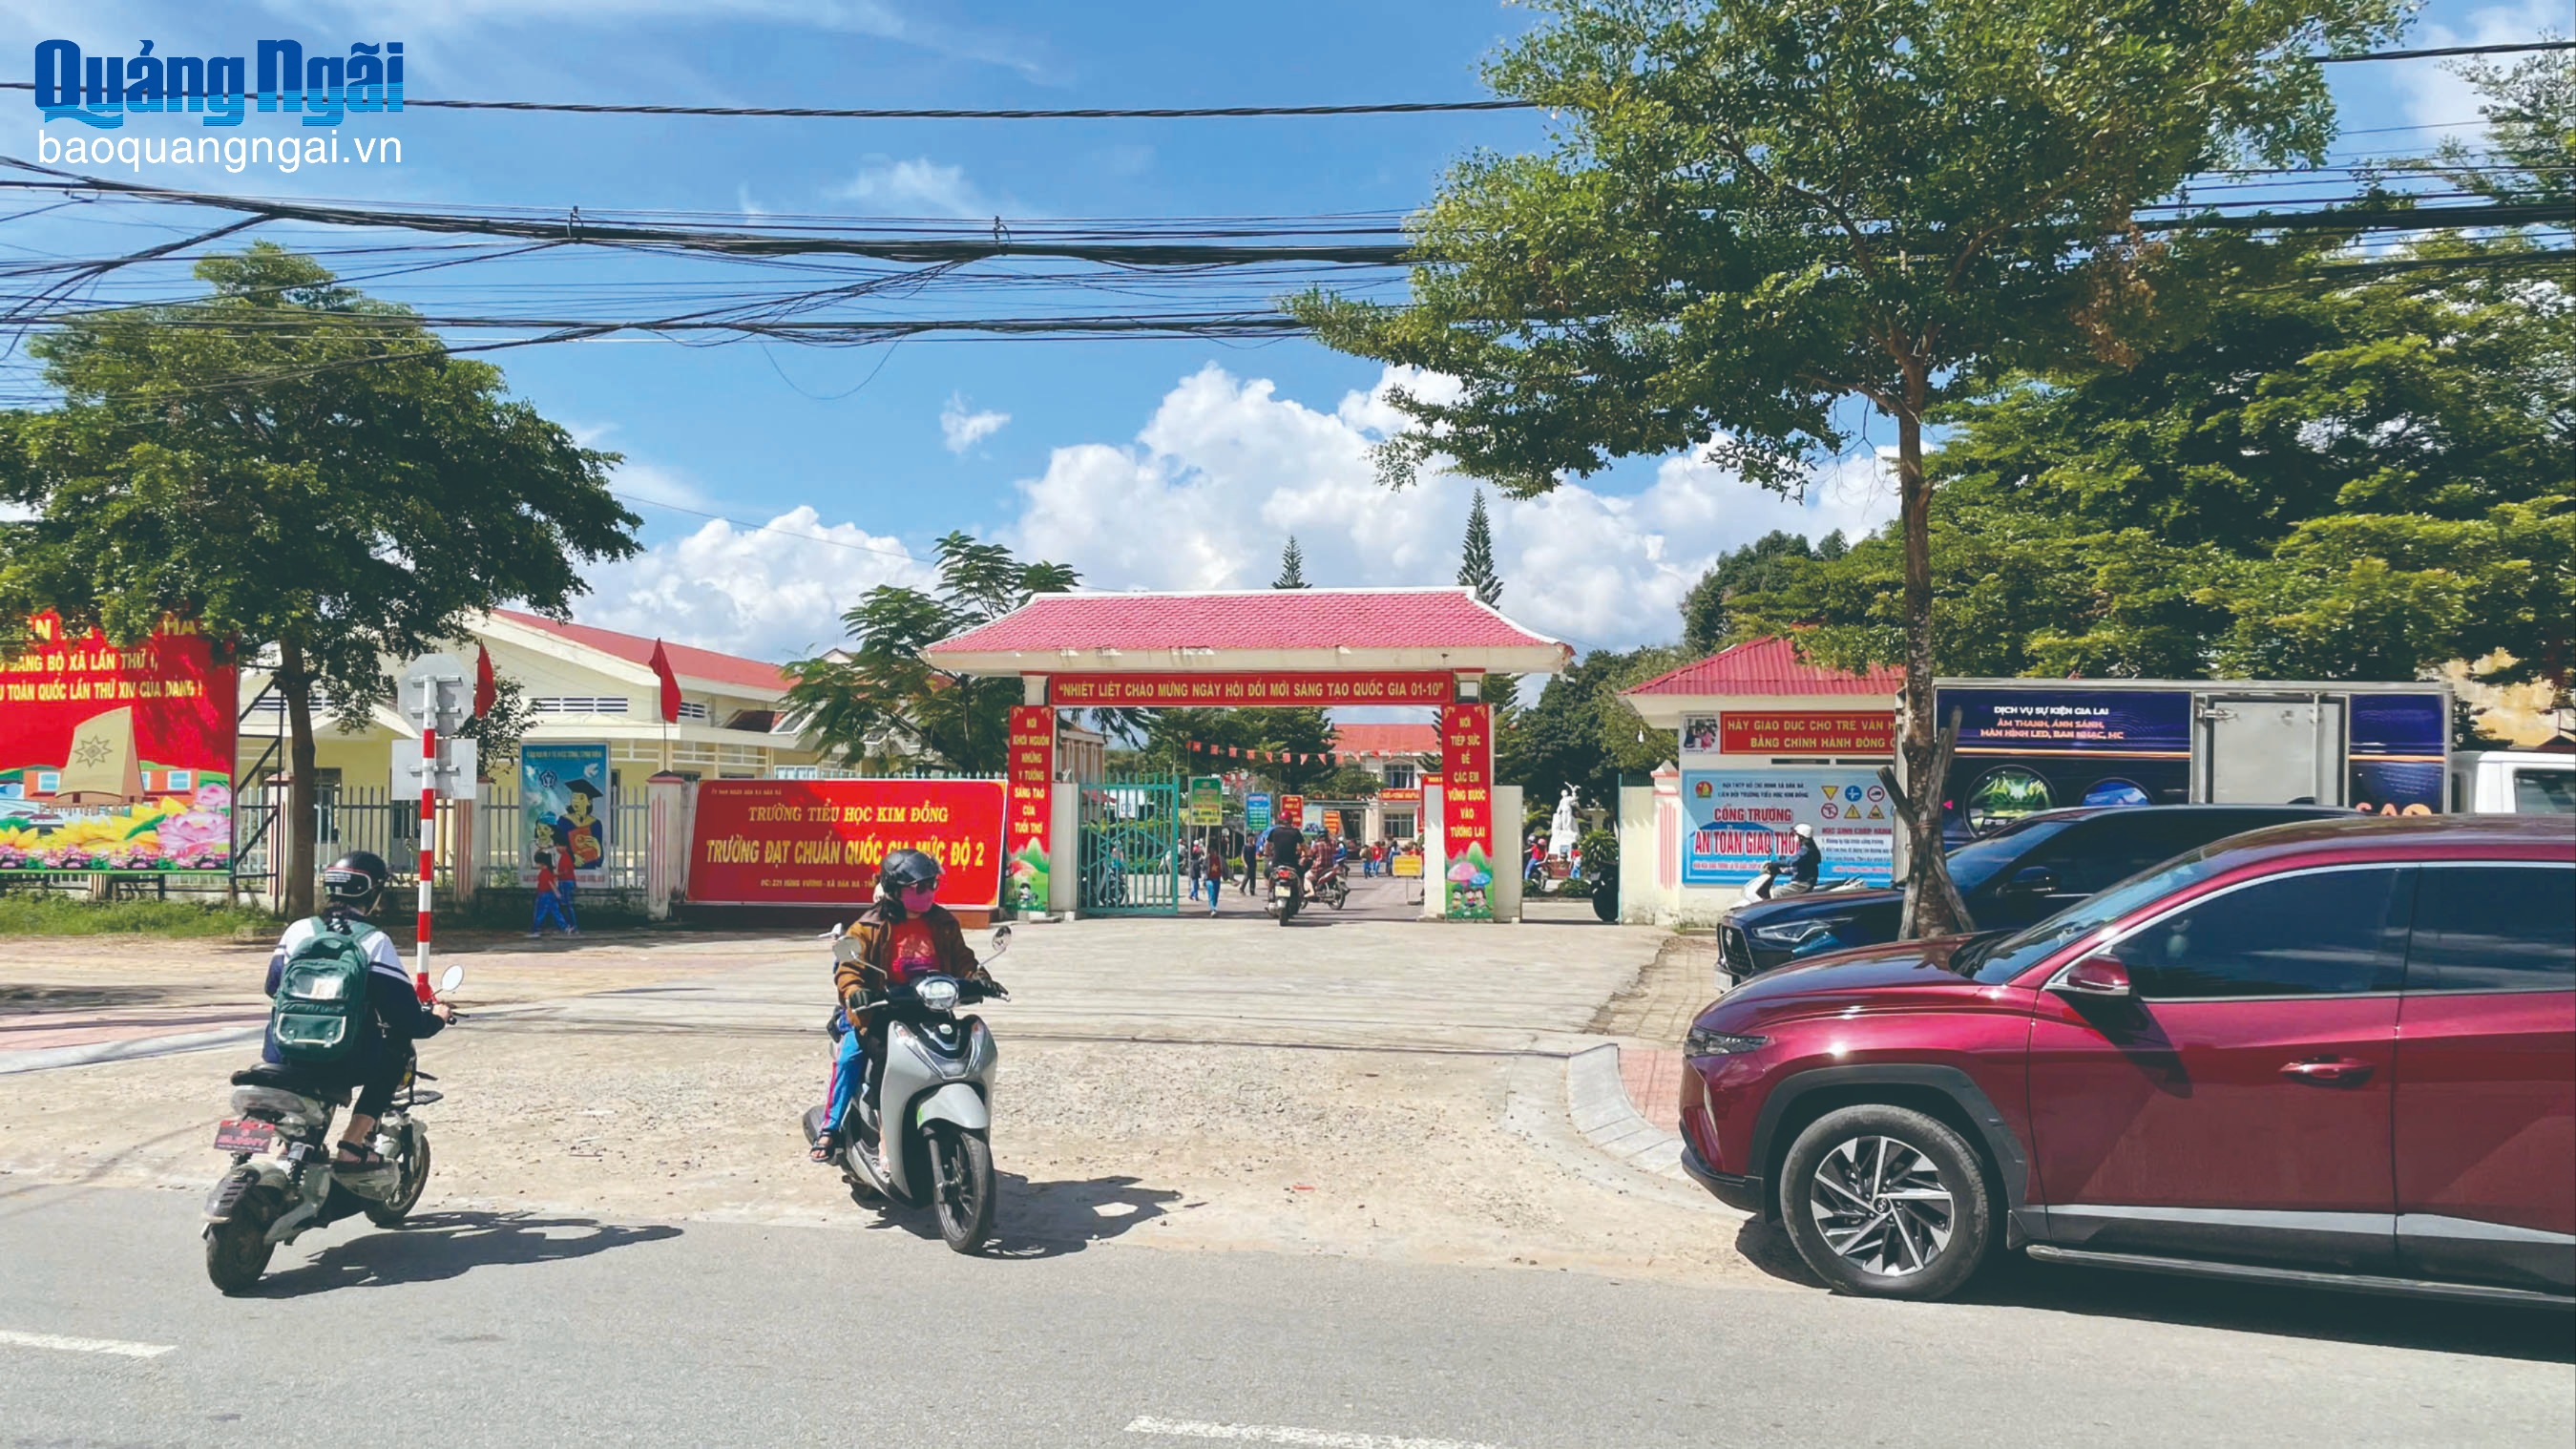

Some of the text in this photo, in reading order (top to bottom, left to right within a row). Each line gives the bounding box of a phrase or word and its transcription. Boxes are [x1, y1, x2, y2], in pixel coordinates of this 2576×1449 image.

[47, 650, 65, 676] BỘ
[68, 649, 87, 671] XÃ
[38, 677, 67, 701] QUỐC
[118, 681, 136, 699] XIV
[138, 674, 161, 698] CỦA
[1099, 680, 1121, 701] LIỆT
[1125, 680, 1154, 697] CHÀO
[1158, 679, 1188, 697] MỪNG
[1192, 680, 1222, 697] NGÀY
[1225, 680, 1244, 701] HỘI
[1247, 677, 1266, 697] ĐỔI
[1270, 679, 1288, 697] MỚI
[1293, 679, 1323, 697] SÁNG
[1328, 682, 1349, 701] TẠO
[1353, 678, 1383, 697] QUỐC
[1388, 682, 1407, 697] GIA
[1994, 706, 2018, 716] DỊCH
[2020, 706, 2033, 716] VỤ
[2035, 706, 2049, 716] SỰ
[2049, 706, 2073, 716] KIỆN
[1810, 720, 1832, 731] CHO
[1451, 732, 1480, 746] TIẾP SỨC
[1980, 727, 2003, 737] MÀN
[2004, 727, 2029, 737] HÌNH
[2030, 729, 2051, 739] LED,
[2053, 730, 2074, 739] BAN
[2107, 731, 2124, 740] MC
[1454, 768, 1467, 782] CÁC
[1469, 770, 1479, 782] EM
[1015, 784, 1031, 798] SÁNG
[1447, 787, 1466, 801] VỮNG
[748, 798, 949, 826] TRƯỜNG TIỂU HỌC KIM ĐỒNG
[1022, 802, 1036, 816] CỦA
[1460, 805, 1475, 819] VÀO
[1474, 826, 1486, 838] LAI
[1694, 830, 1710, 853] AN
[1713, 825, 1742, 854] TOÀN
[1745, 830, 1772, 854] GIAO
[706, 833, 760, 864] TRƯỜNG
[764, 839, 791, 869] ĐẠT
[794, 830, 840, 865] CHUẨN
[845, 832, 883, 867] QUỐC
[950, 836, 971, 872] ĐỘ
[974, 841, 985, 867] 2
